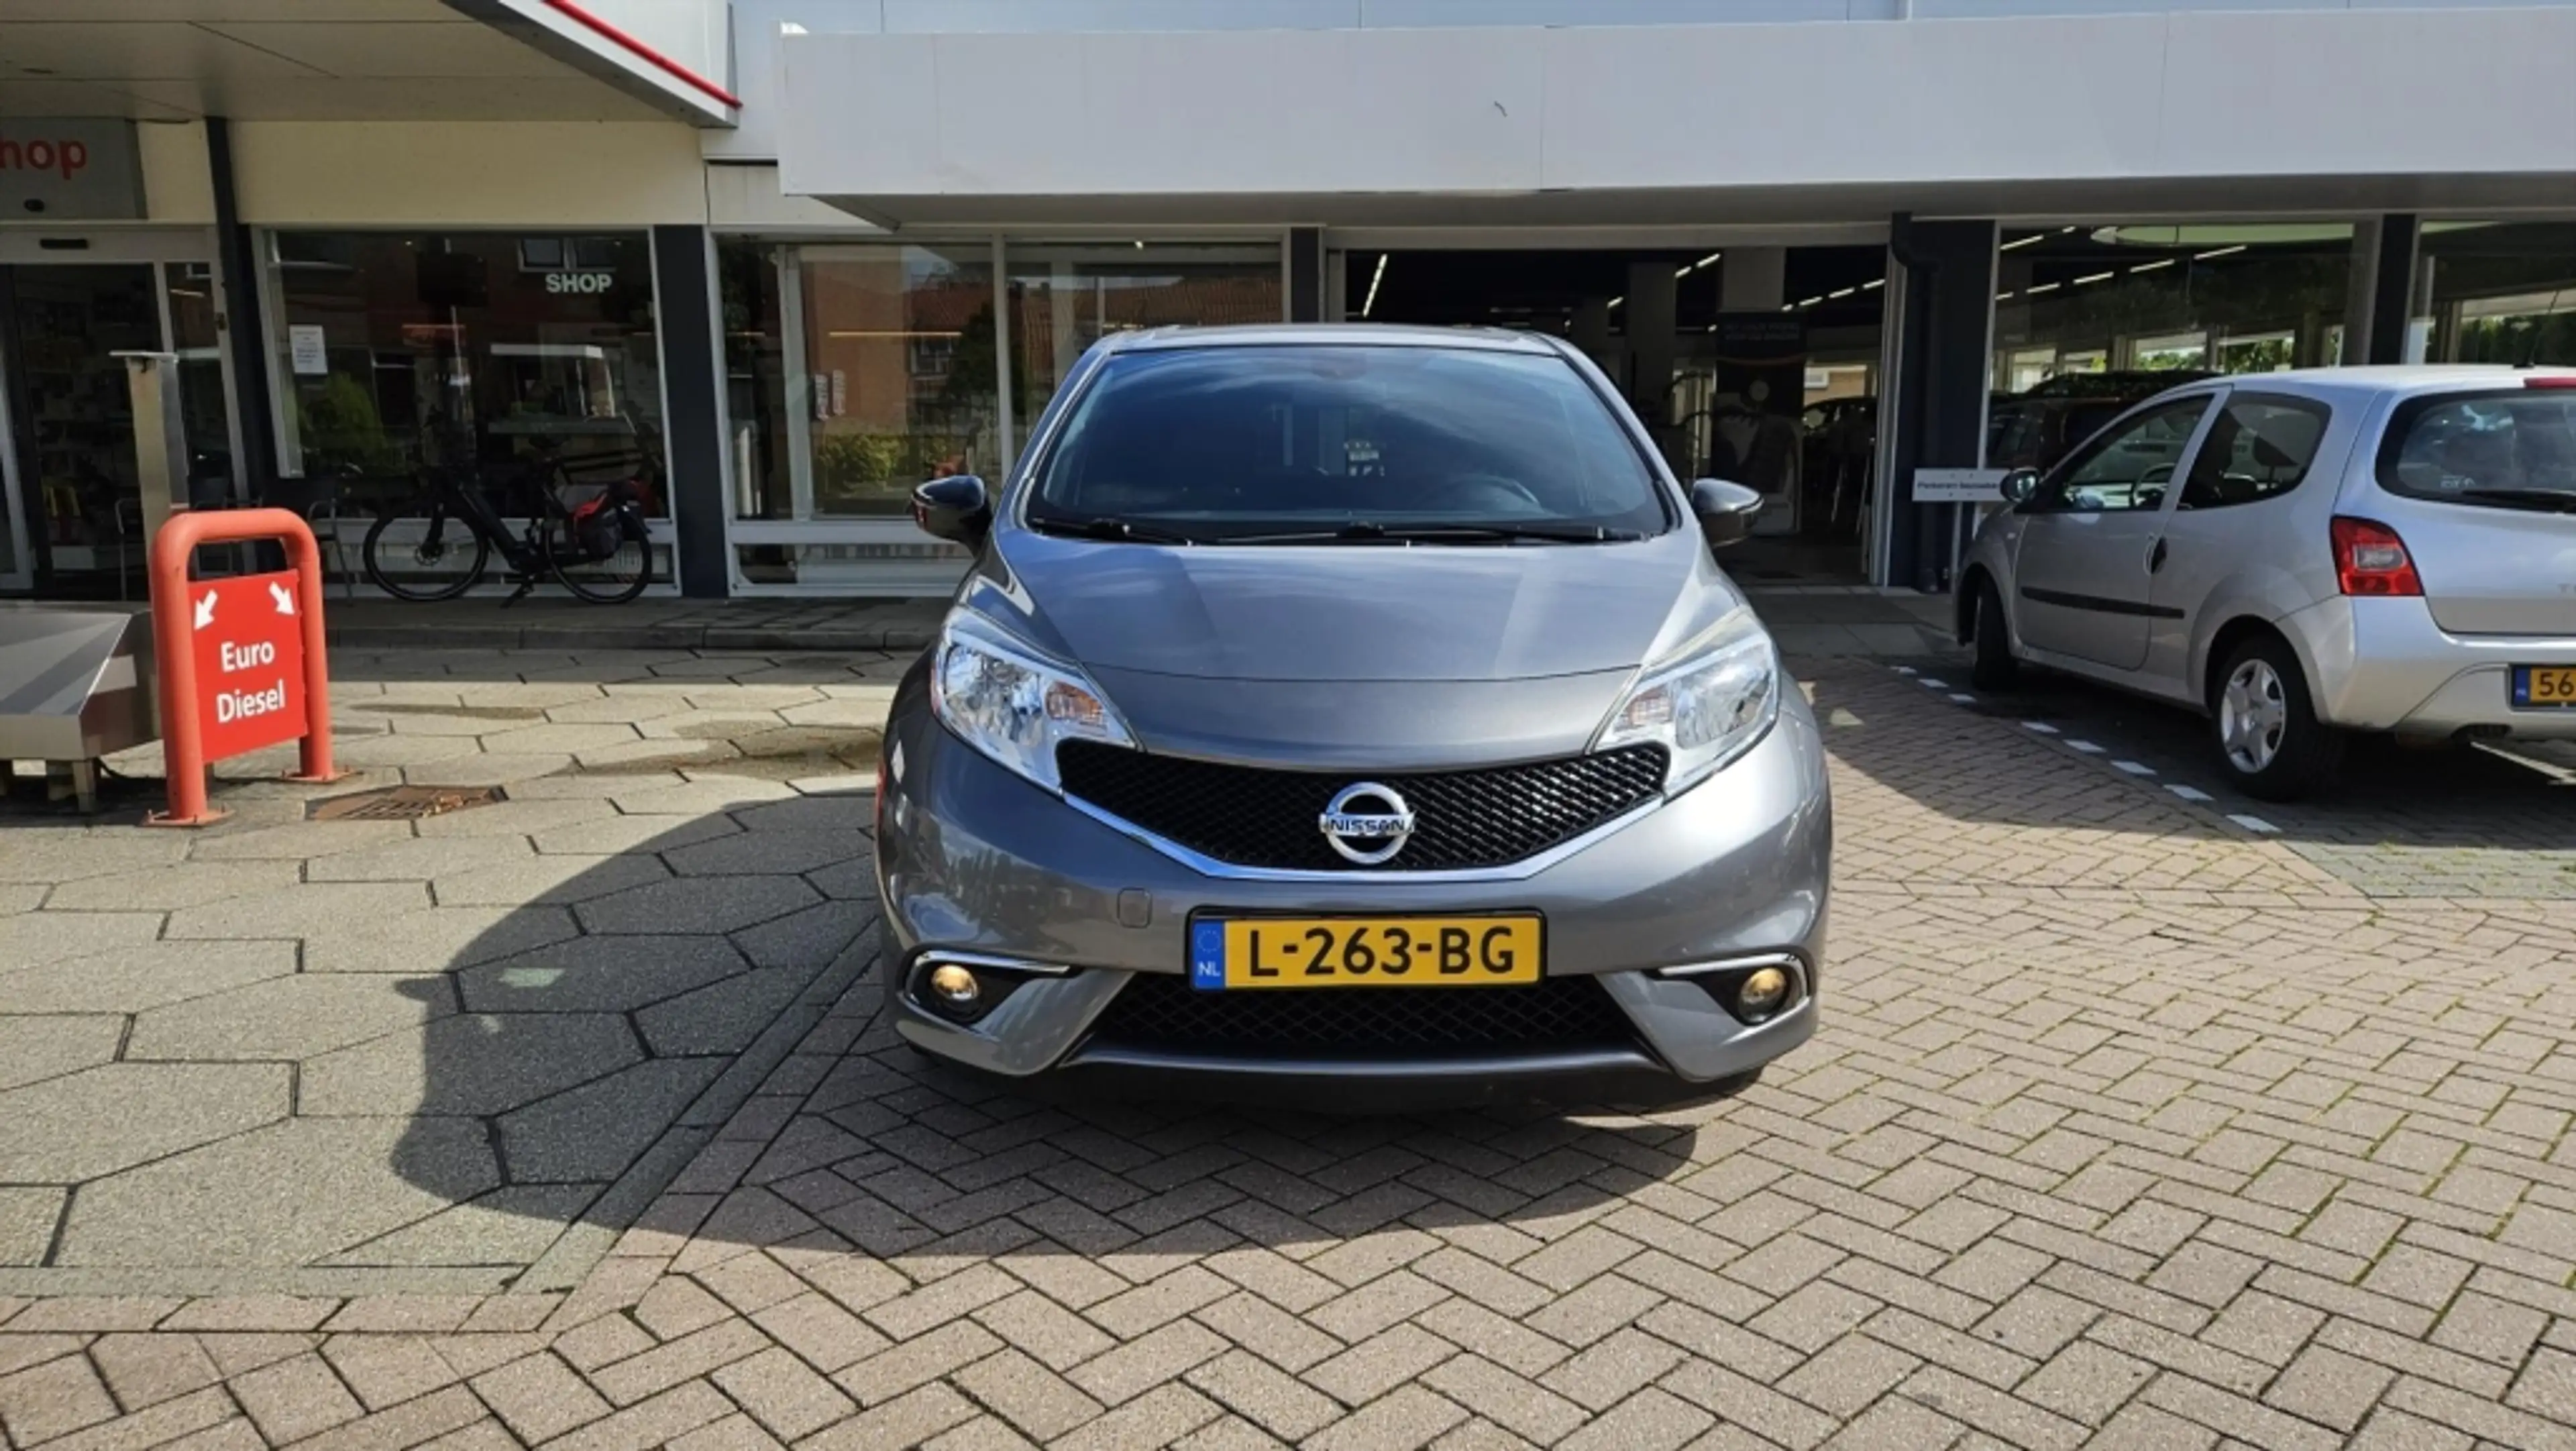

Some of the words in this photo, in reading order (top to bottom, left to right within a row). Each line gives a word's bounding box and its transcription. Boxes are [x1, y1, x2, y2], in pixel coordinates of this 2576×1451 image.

[545, 273, 612, 293] SHOP
[221, 641, 275, 673] Euro
[216, 678, 286, 724] Diesel
[1331, 819, 1405, 831] NISSAN
[1249, 926, 1515, 977] L-263-BG
[1197, 961, 1221, 977] NL
